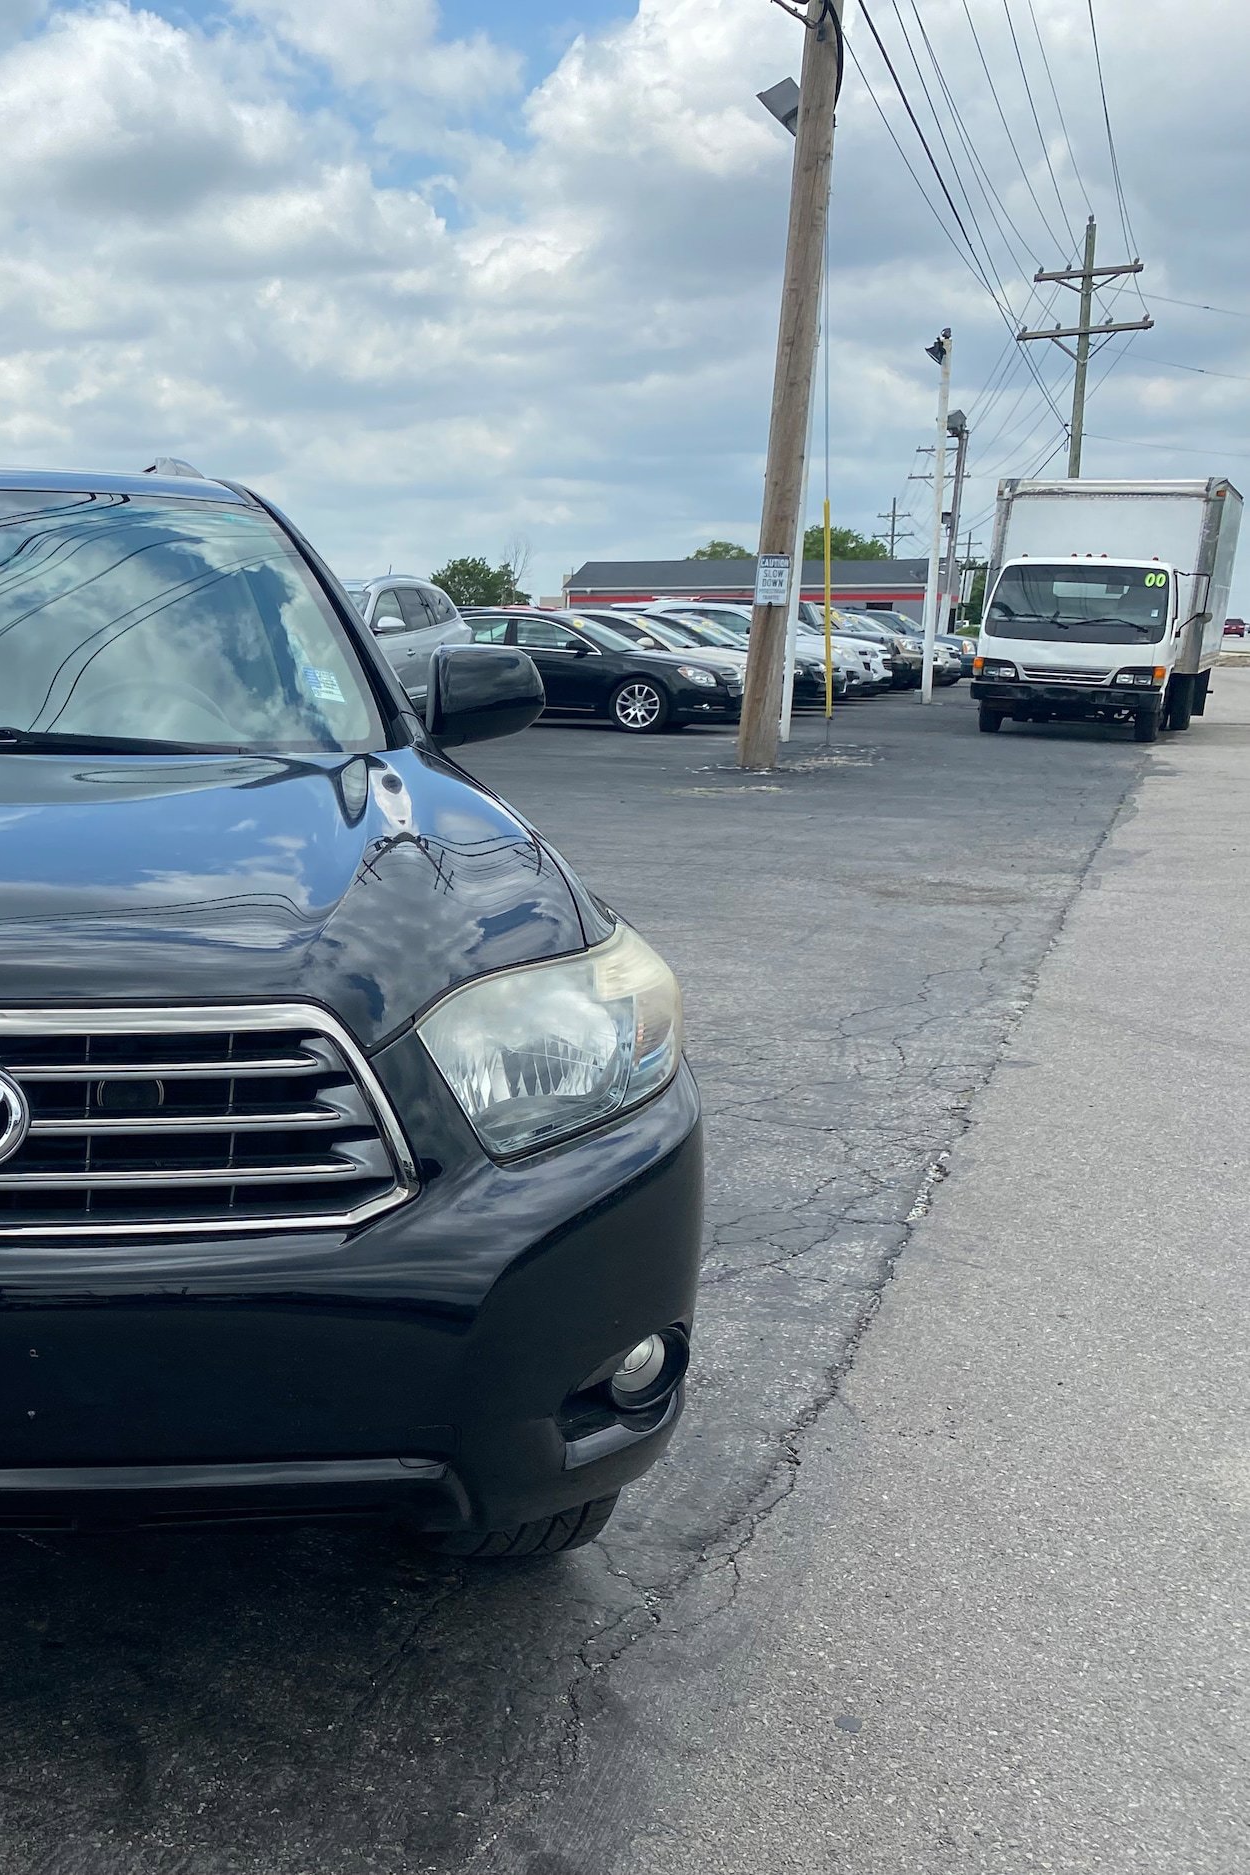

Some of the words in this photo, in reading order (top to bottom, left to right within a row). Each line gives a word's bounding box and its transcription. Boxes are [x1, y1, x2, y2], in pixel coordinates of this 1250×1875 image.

[760, 558, 789, 567] CAUTION
[763, 569, 785, 578] SLOW
[762, 579, 784, 587] DOWN
[1144, 572, 1167, 588] 00
